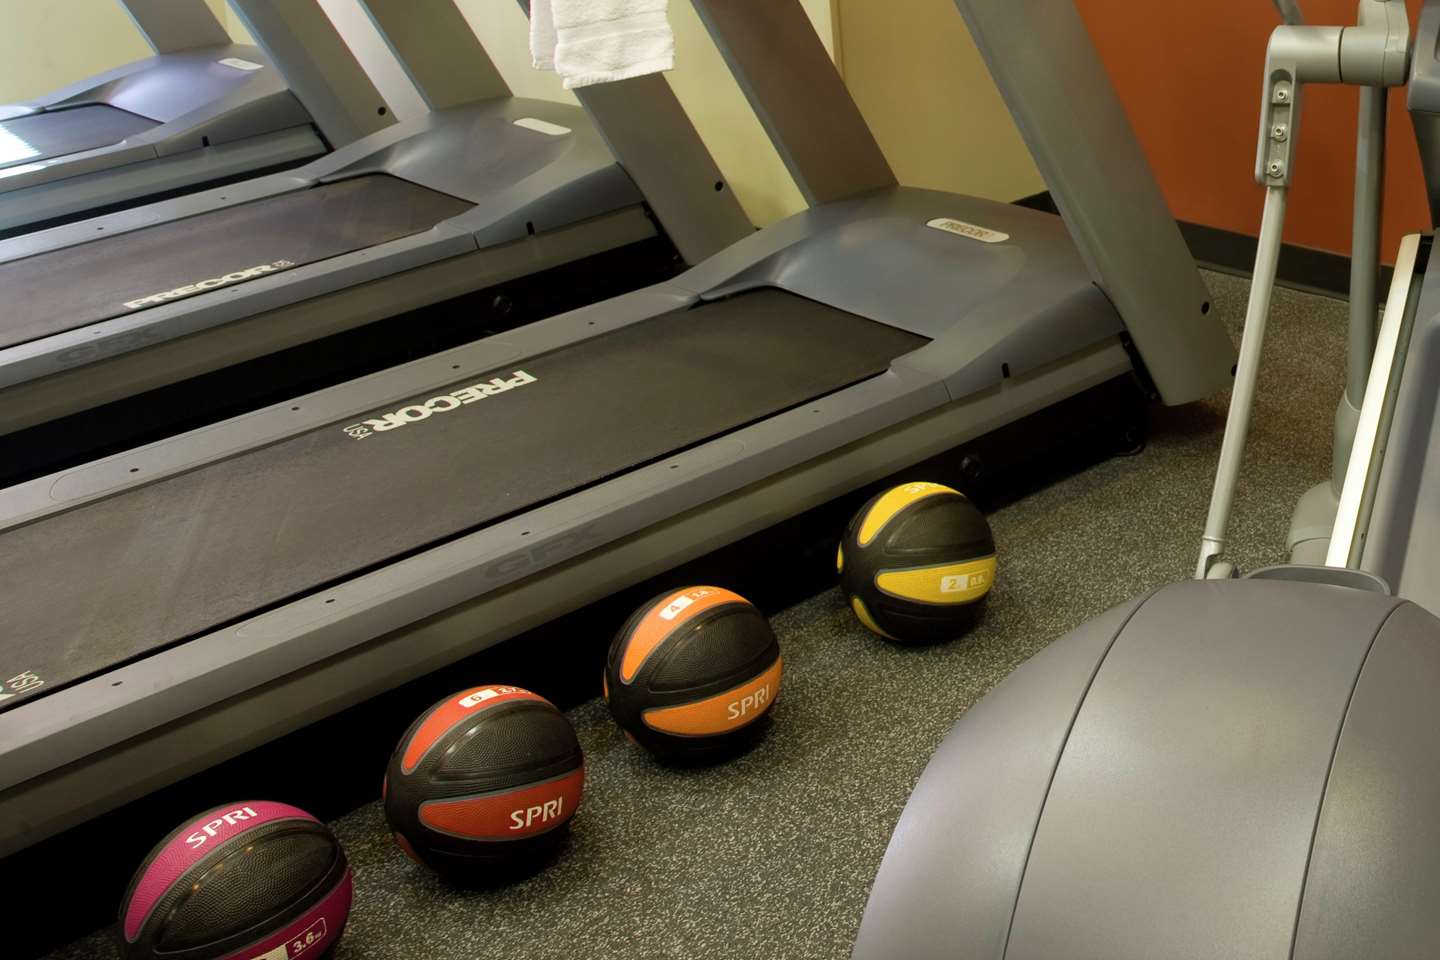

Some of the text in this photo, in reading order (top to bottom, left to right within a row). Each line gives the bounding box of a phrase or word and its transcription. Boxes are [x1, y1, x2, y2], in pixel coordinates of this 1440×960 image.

[122, 264, 277, 309] PRECOR
[363, 370, 538, 433] PRECOR
[727, 684, 769, 721] SPRI
[185, 806, 258, 849] SPRI
[509, 796, 564, 830] SPRI
[292, 931, 314, 953] 3.6
